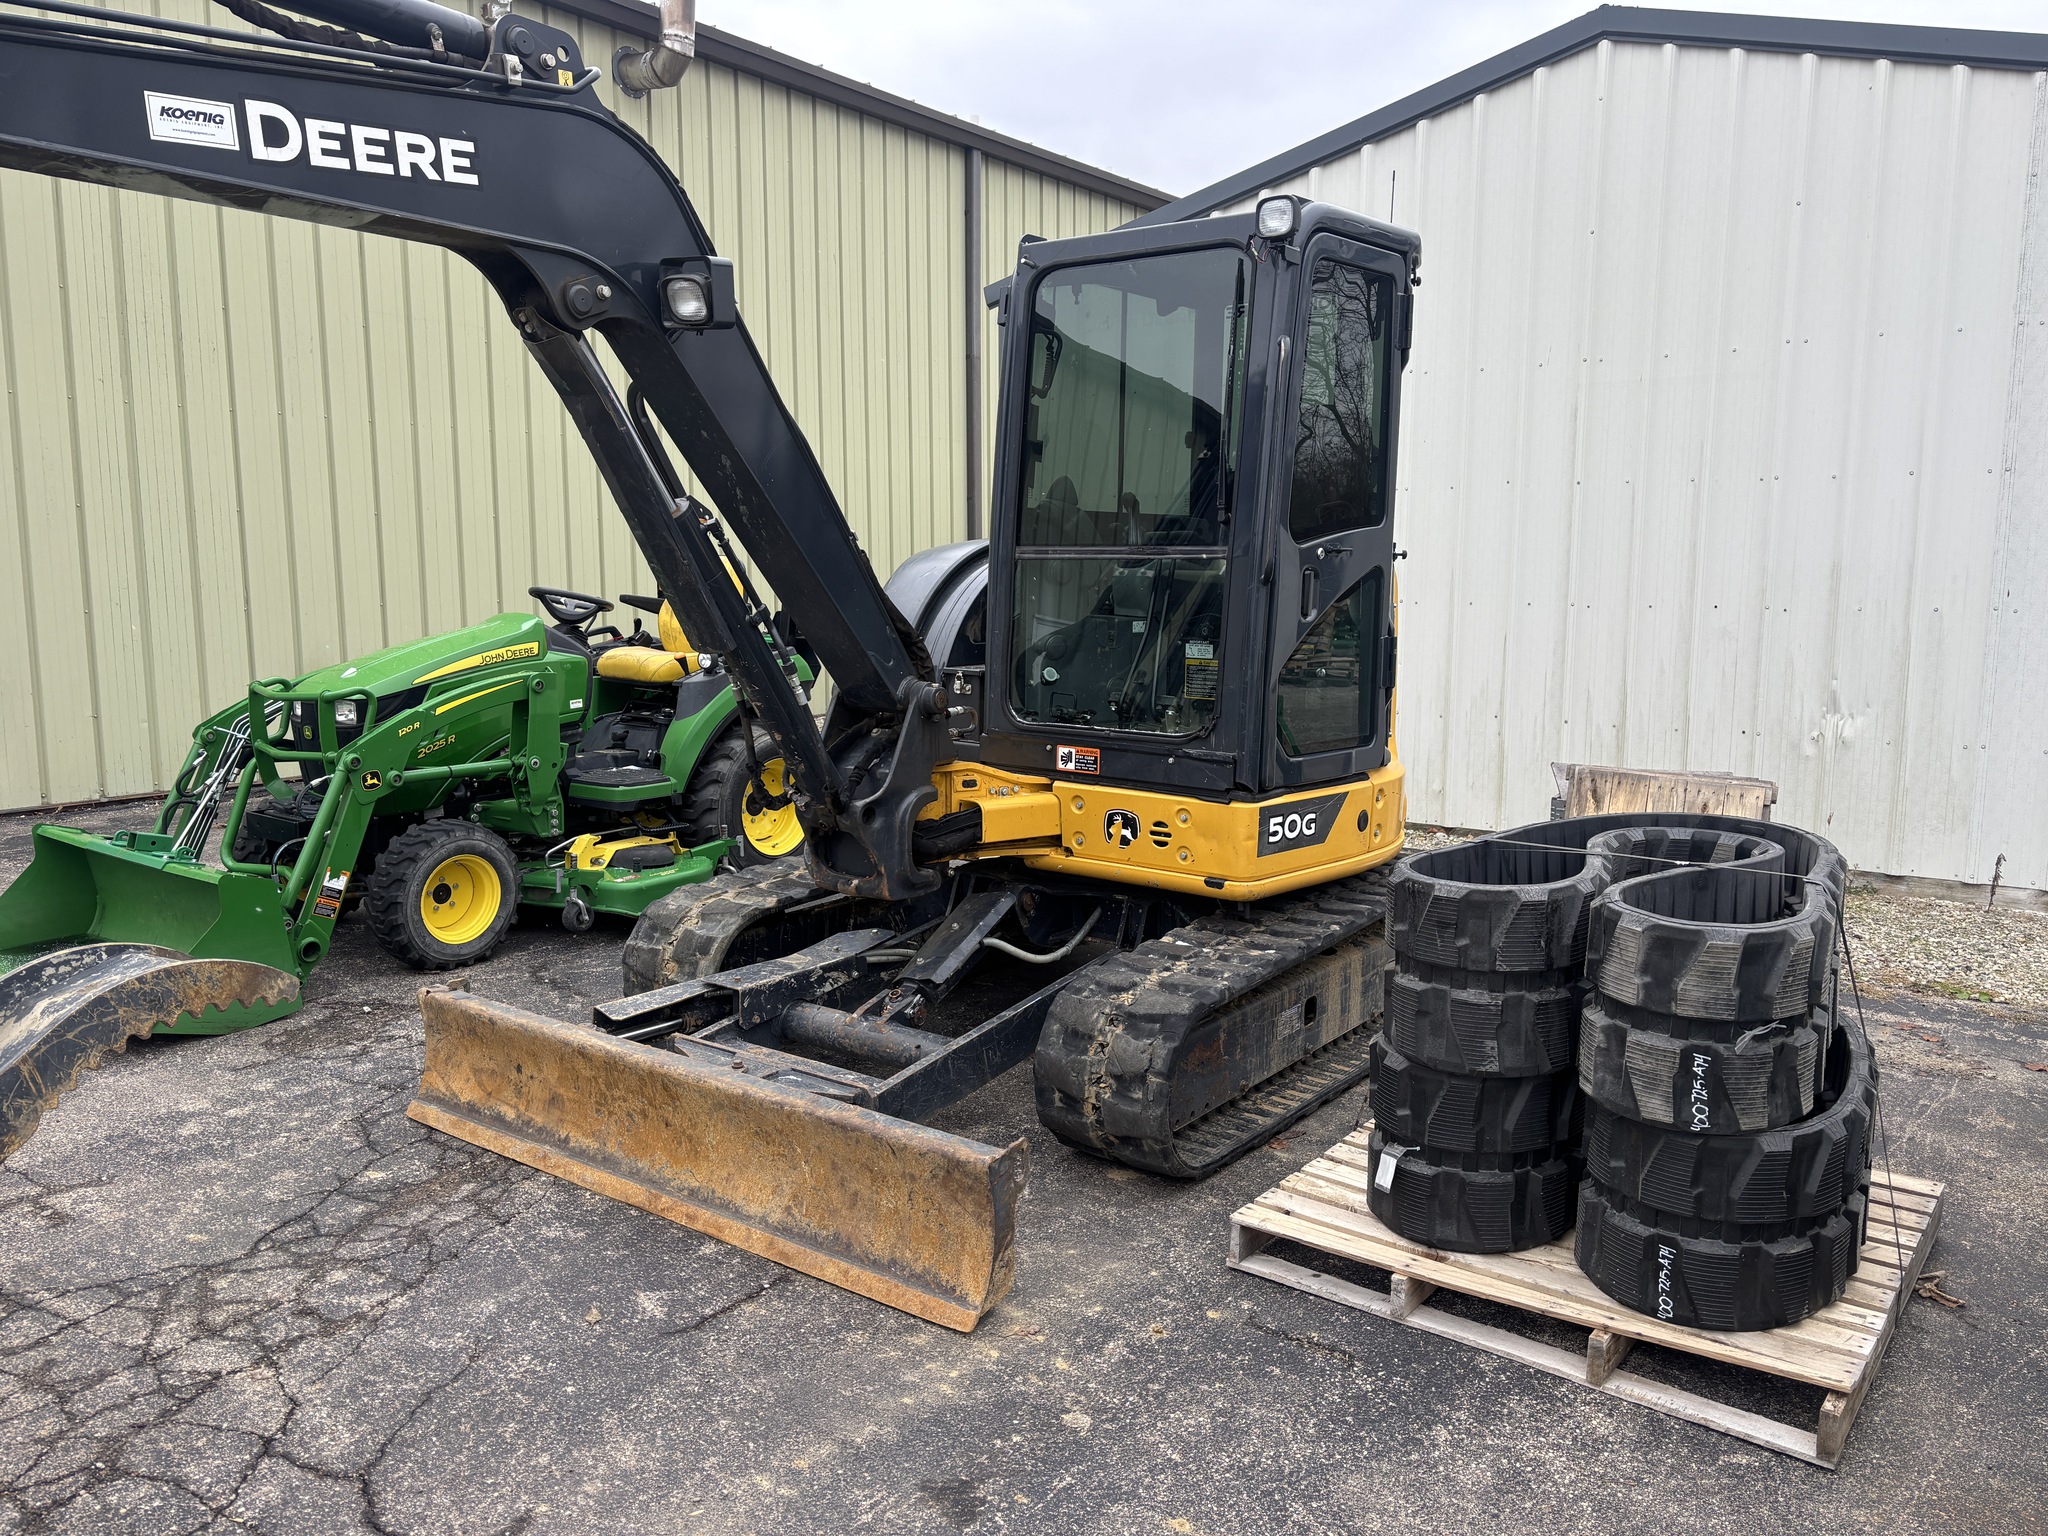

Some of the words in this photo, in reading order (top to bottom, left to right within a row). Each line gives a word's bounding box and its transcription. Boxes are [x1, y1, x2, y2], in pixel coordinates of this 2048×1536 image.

[244, 99, 479, 185] DEERE
[480, 652, 504, 665] JOHN
[505, 647, 535, 659] DEERE
[398, 725, 413, 737] 120
[413, 721, 420, 730] R
[417, 738, 446, 759] 2025
[448, 734, 456, 745] R
[1268, 812, 1316, 843] 50G
